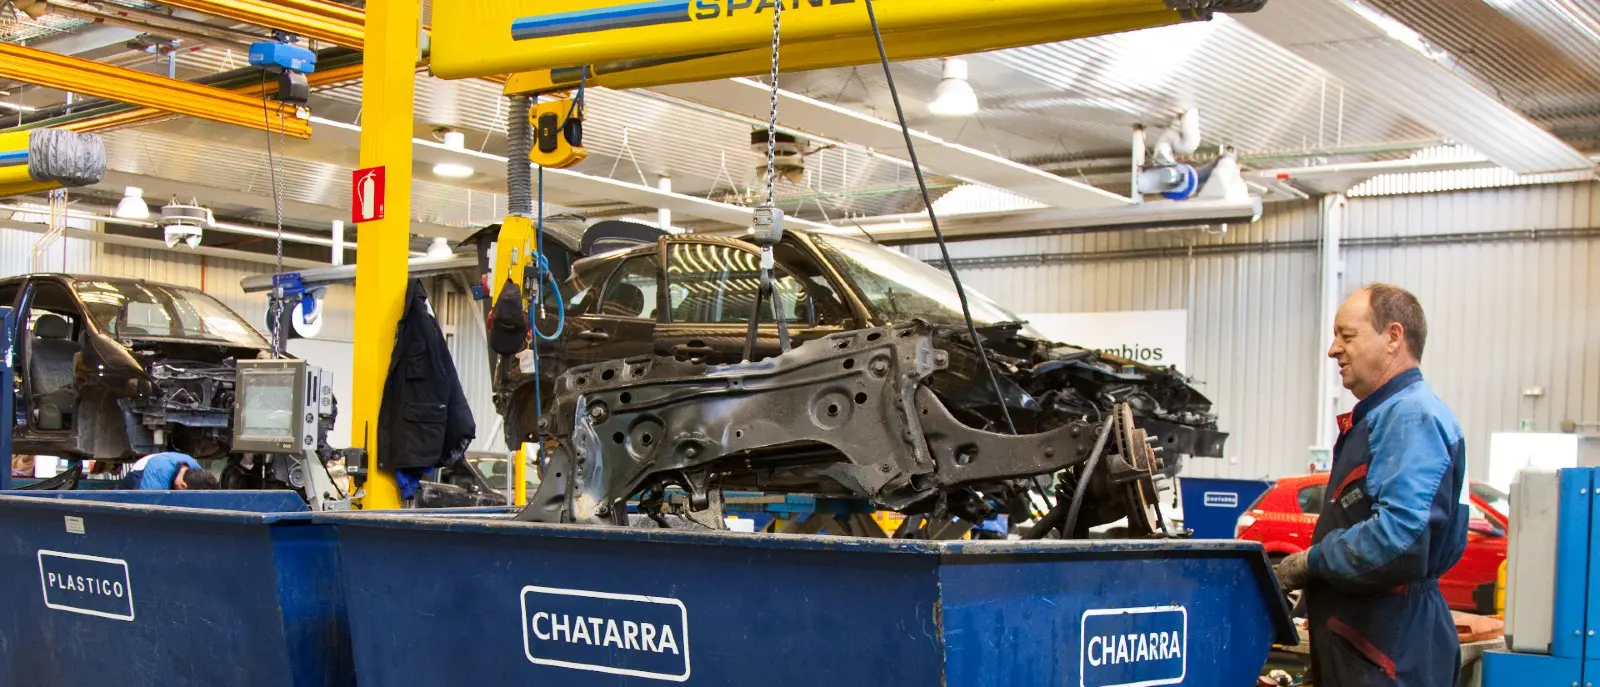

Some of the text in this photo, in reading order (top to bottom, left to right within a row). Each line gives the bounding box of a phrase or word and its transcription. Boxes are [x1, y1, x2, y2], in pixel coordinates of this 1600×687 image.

[1097, 343, 1163, 361] mbios
[48, 572, 123, 598] PLASTICO
[532, 611, 680, 655] CHATARRA
[1087, 630, 1182, 667] CHATARRA
